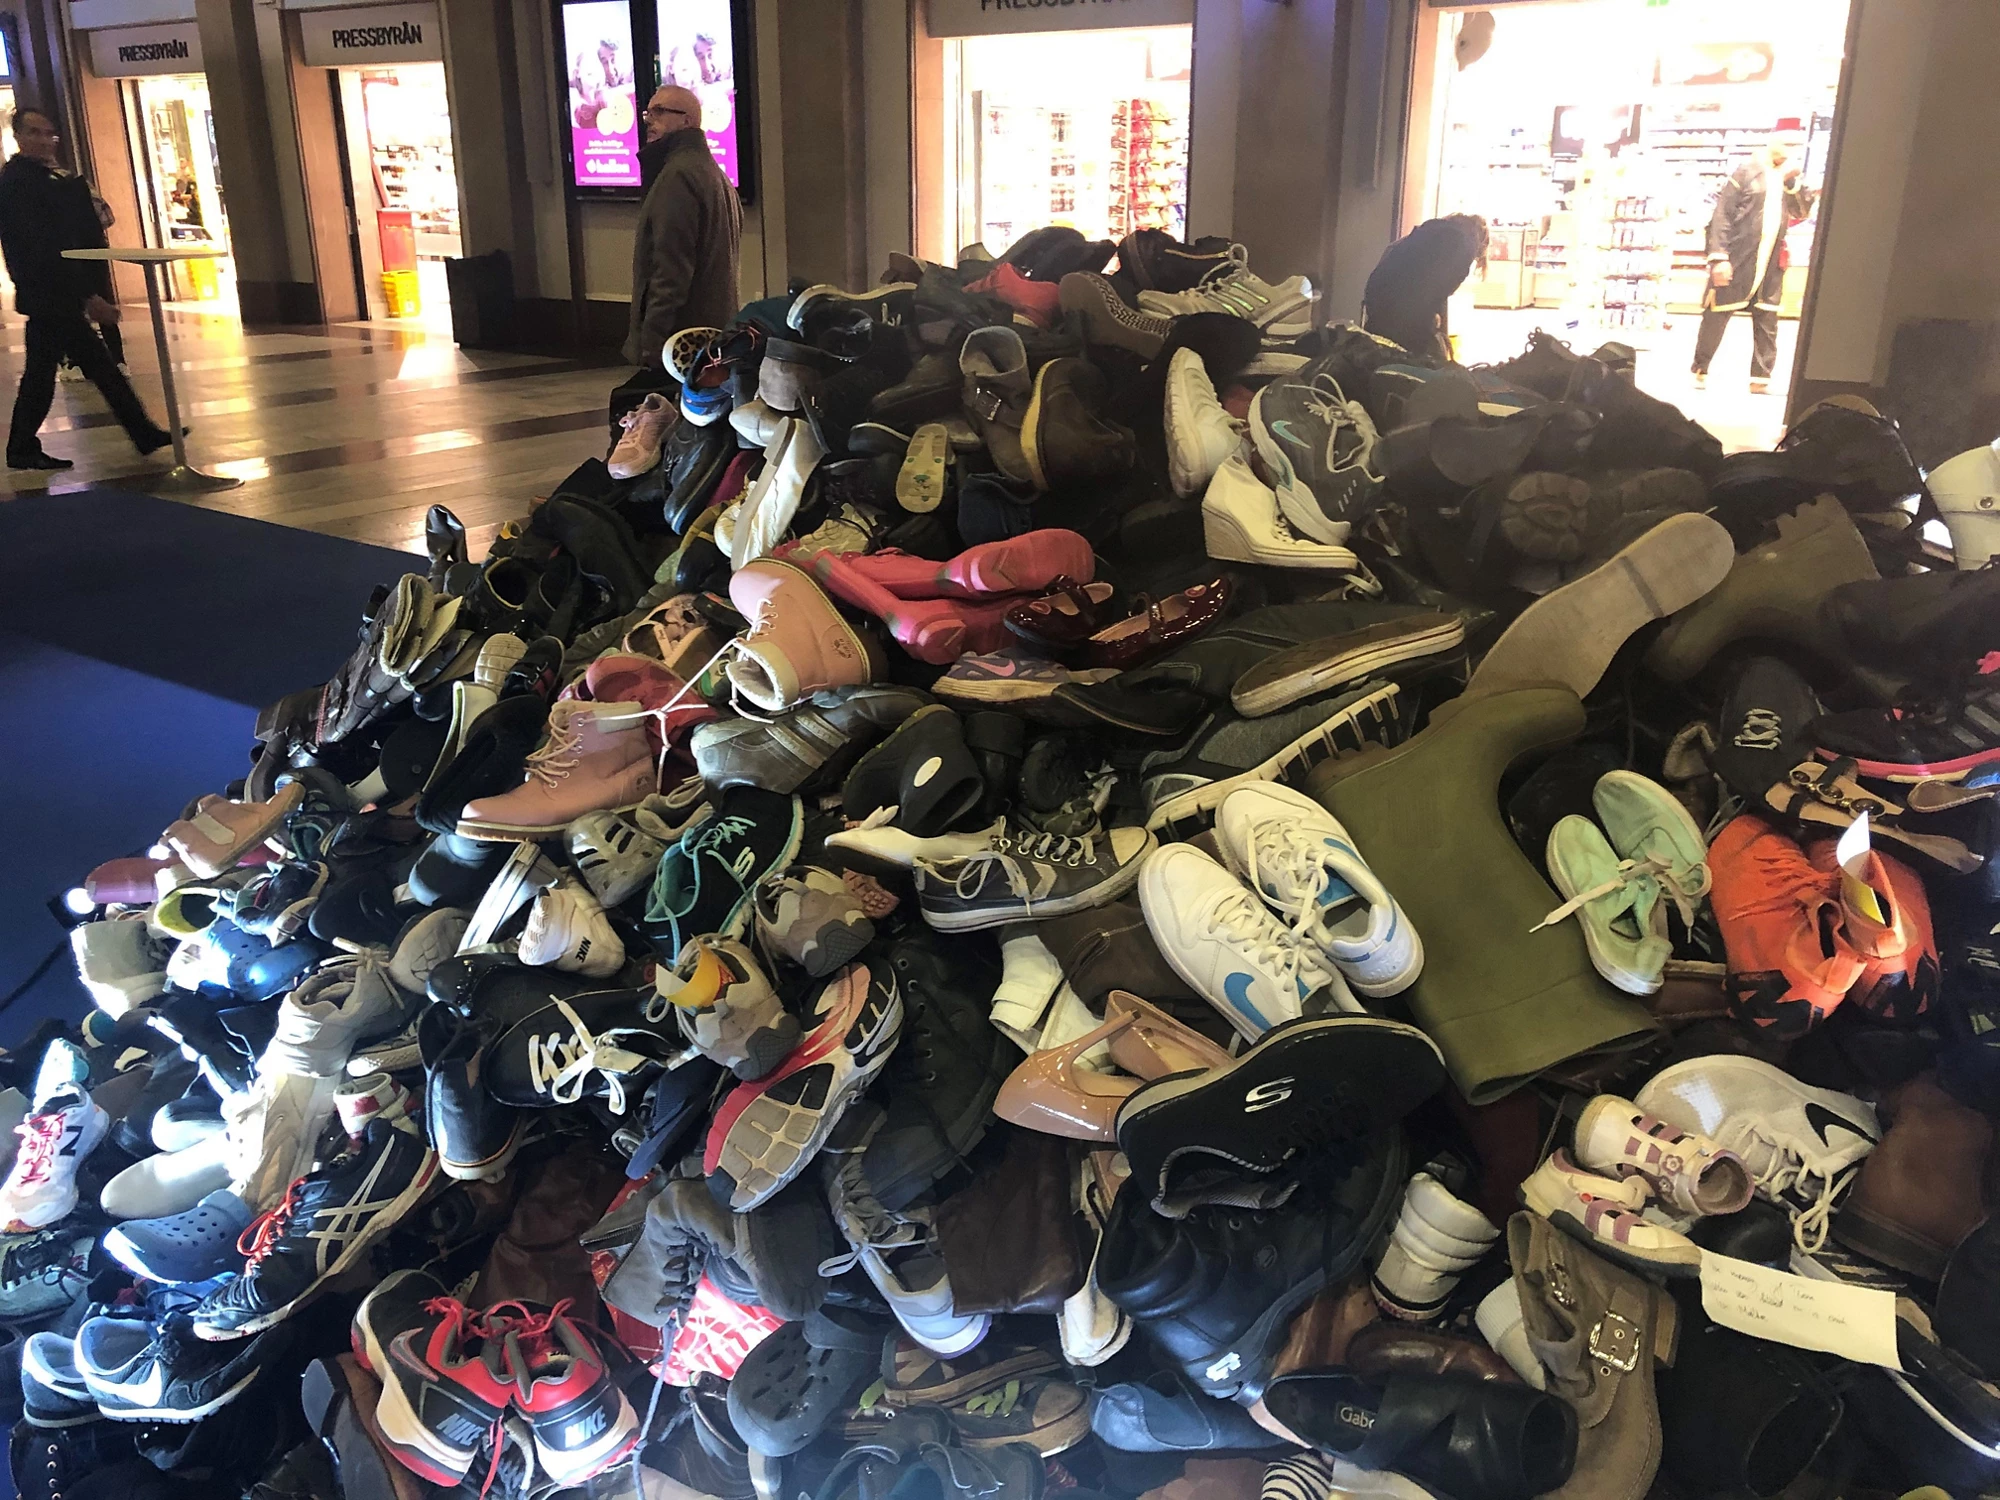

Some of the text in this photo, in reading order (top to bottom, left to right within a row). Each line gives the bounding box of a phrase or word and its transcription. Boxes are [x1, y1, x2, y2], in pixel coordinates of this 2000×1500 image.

[331, 21, 423, 48] PRESSBYRÅN
[118, 38, 189, 62] PRESSBYRÅN
[575, 936, 592, 963] NIKE
[437, 1413, 486, 1446] NIKE
[564, 1406, 607, 1448] NIKE
